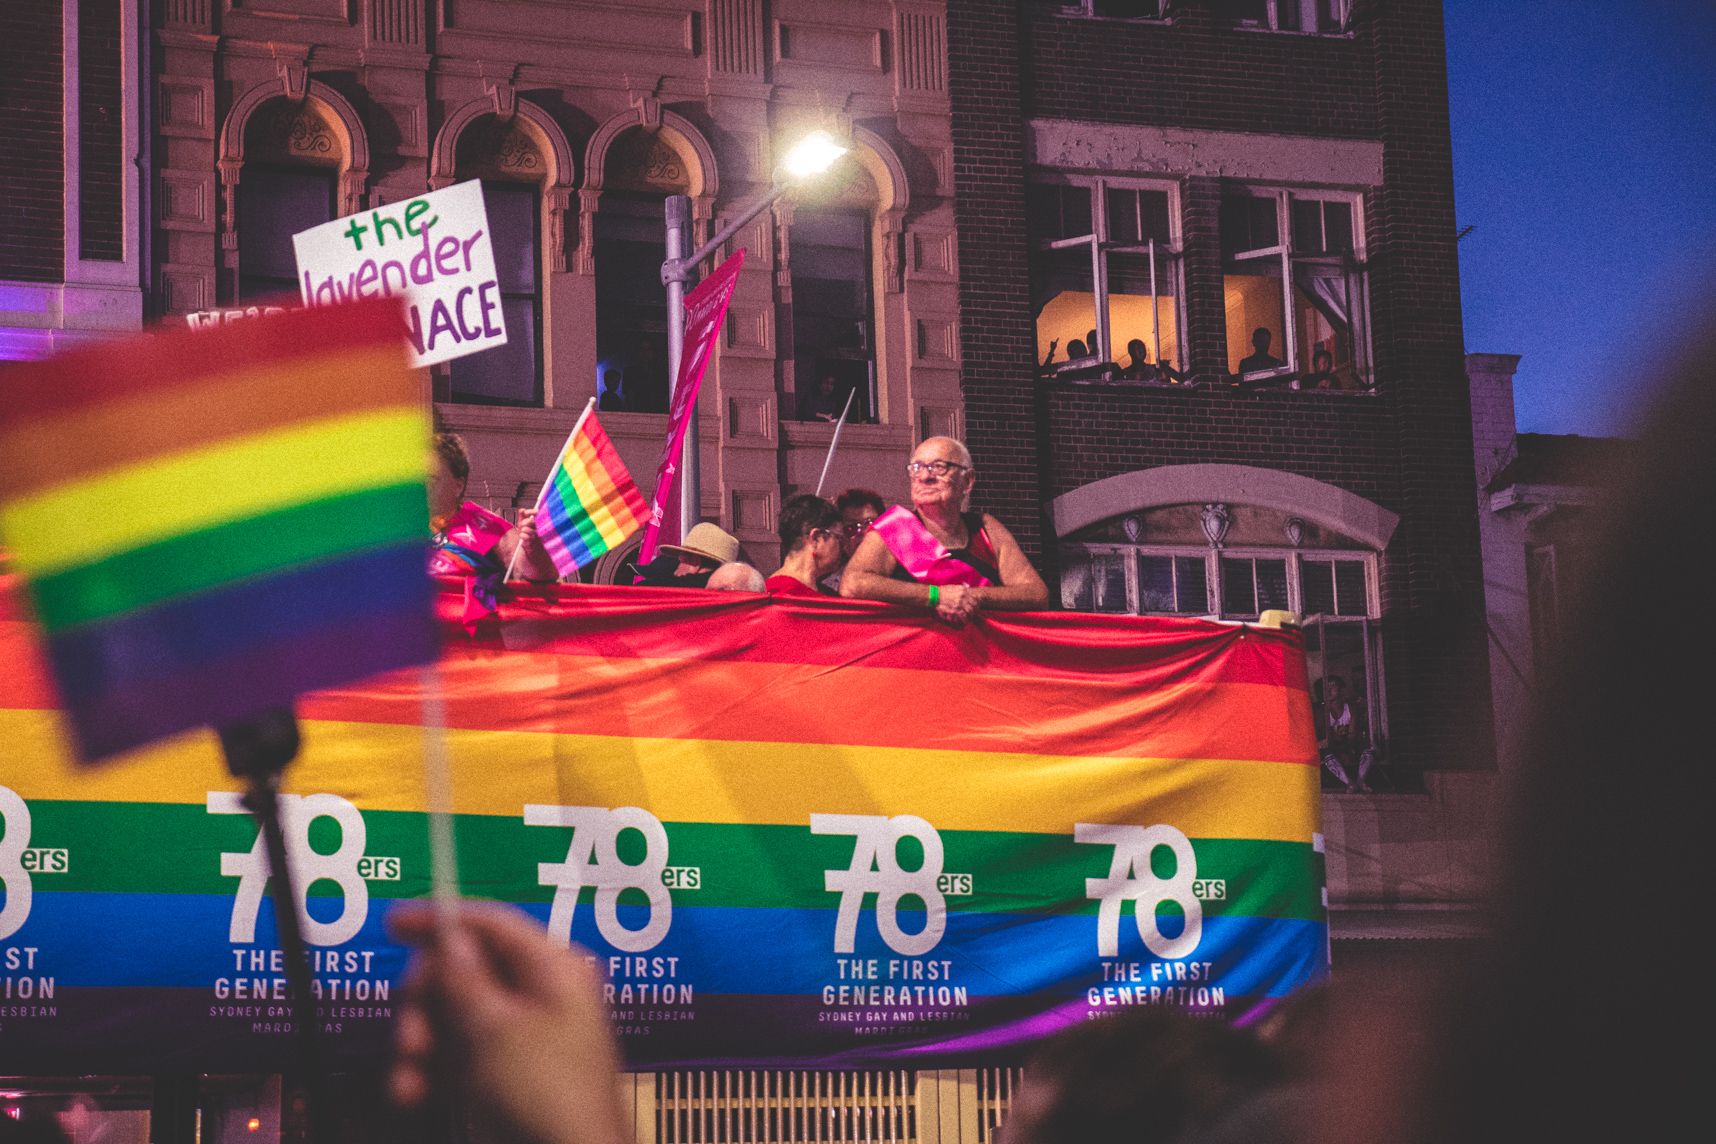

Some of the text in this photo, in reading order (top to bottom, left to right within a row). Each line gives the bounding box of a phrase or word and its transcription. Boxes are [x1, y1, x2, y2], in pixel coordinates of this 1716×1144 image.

[344, 198, 438, 251] the
[304, 221, 484, 308] lavender
[402, 279, 502, 355] NACE
[233, 949, 285, 972] THE
[609, 956, 679, 979] FIRST
[837, 959, 952, 981] THE FIRST
[1102, 962, 1212, 982] THE FIRST
[214, 977, 390, 1001] GENEATION
[603, 983, 693, 1005] RATION
[823, 985, 968, 1006] GENERATION
[1087, 985, 1225, 1006] GENERATION
[0, 1006, 57, 1017] ESBIAN
[209, 1006, 261, 1017] SYDNEY
[268, 1006, 294, 1017] GAY
[331, 1007, 392, 1018] LESBIAN
[611, 1010, 696, 1021] AND LESBIAN
[818, 1011, 861, 1022] SYDNEY
[866, 1011, 888, 1022] GAY
[893, 1011, 915, 1022] AND
